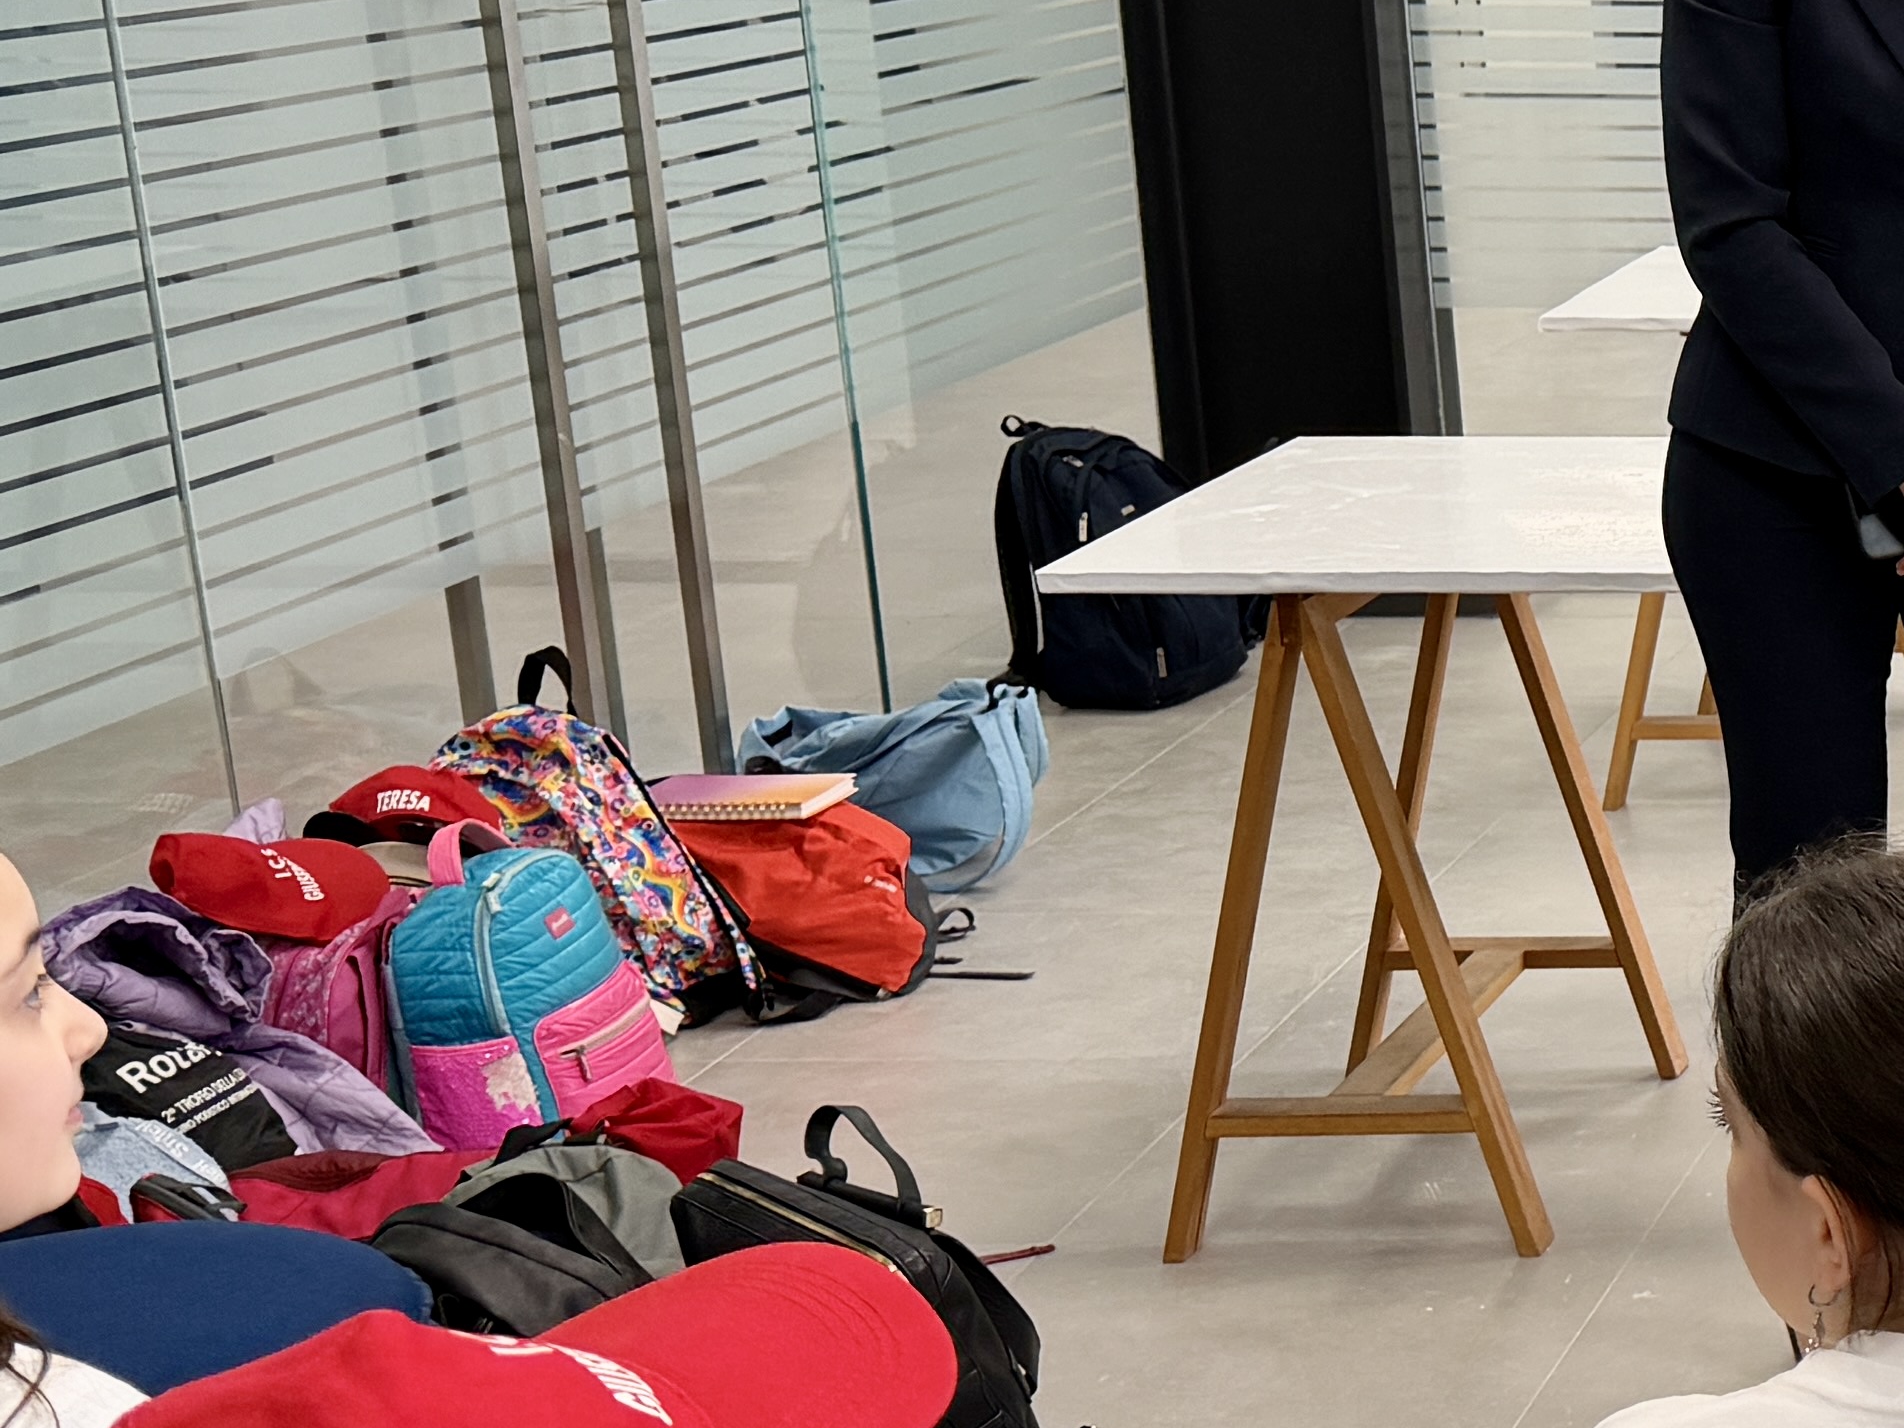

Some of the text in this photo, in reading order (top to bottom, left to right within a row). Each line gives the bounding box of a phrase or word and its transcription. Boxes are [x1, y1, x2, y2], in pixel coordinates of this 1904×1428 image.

[376, 789, 431, 813] TERESA
[116, 1041, 223, 1094] Rotar
[174, 1086, 217, 1114] TROFEO
